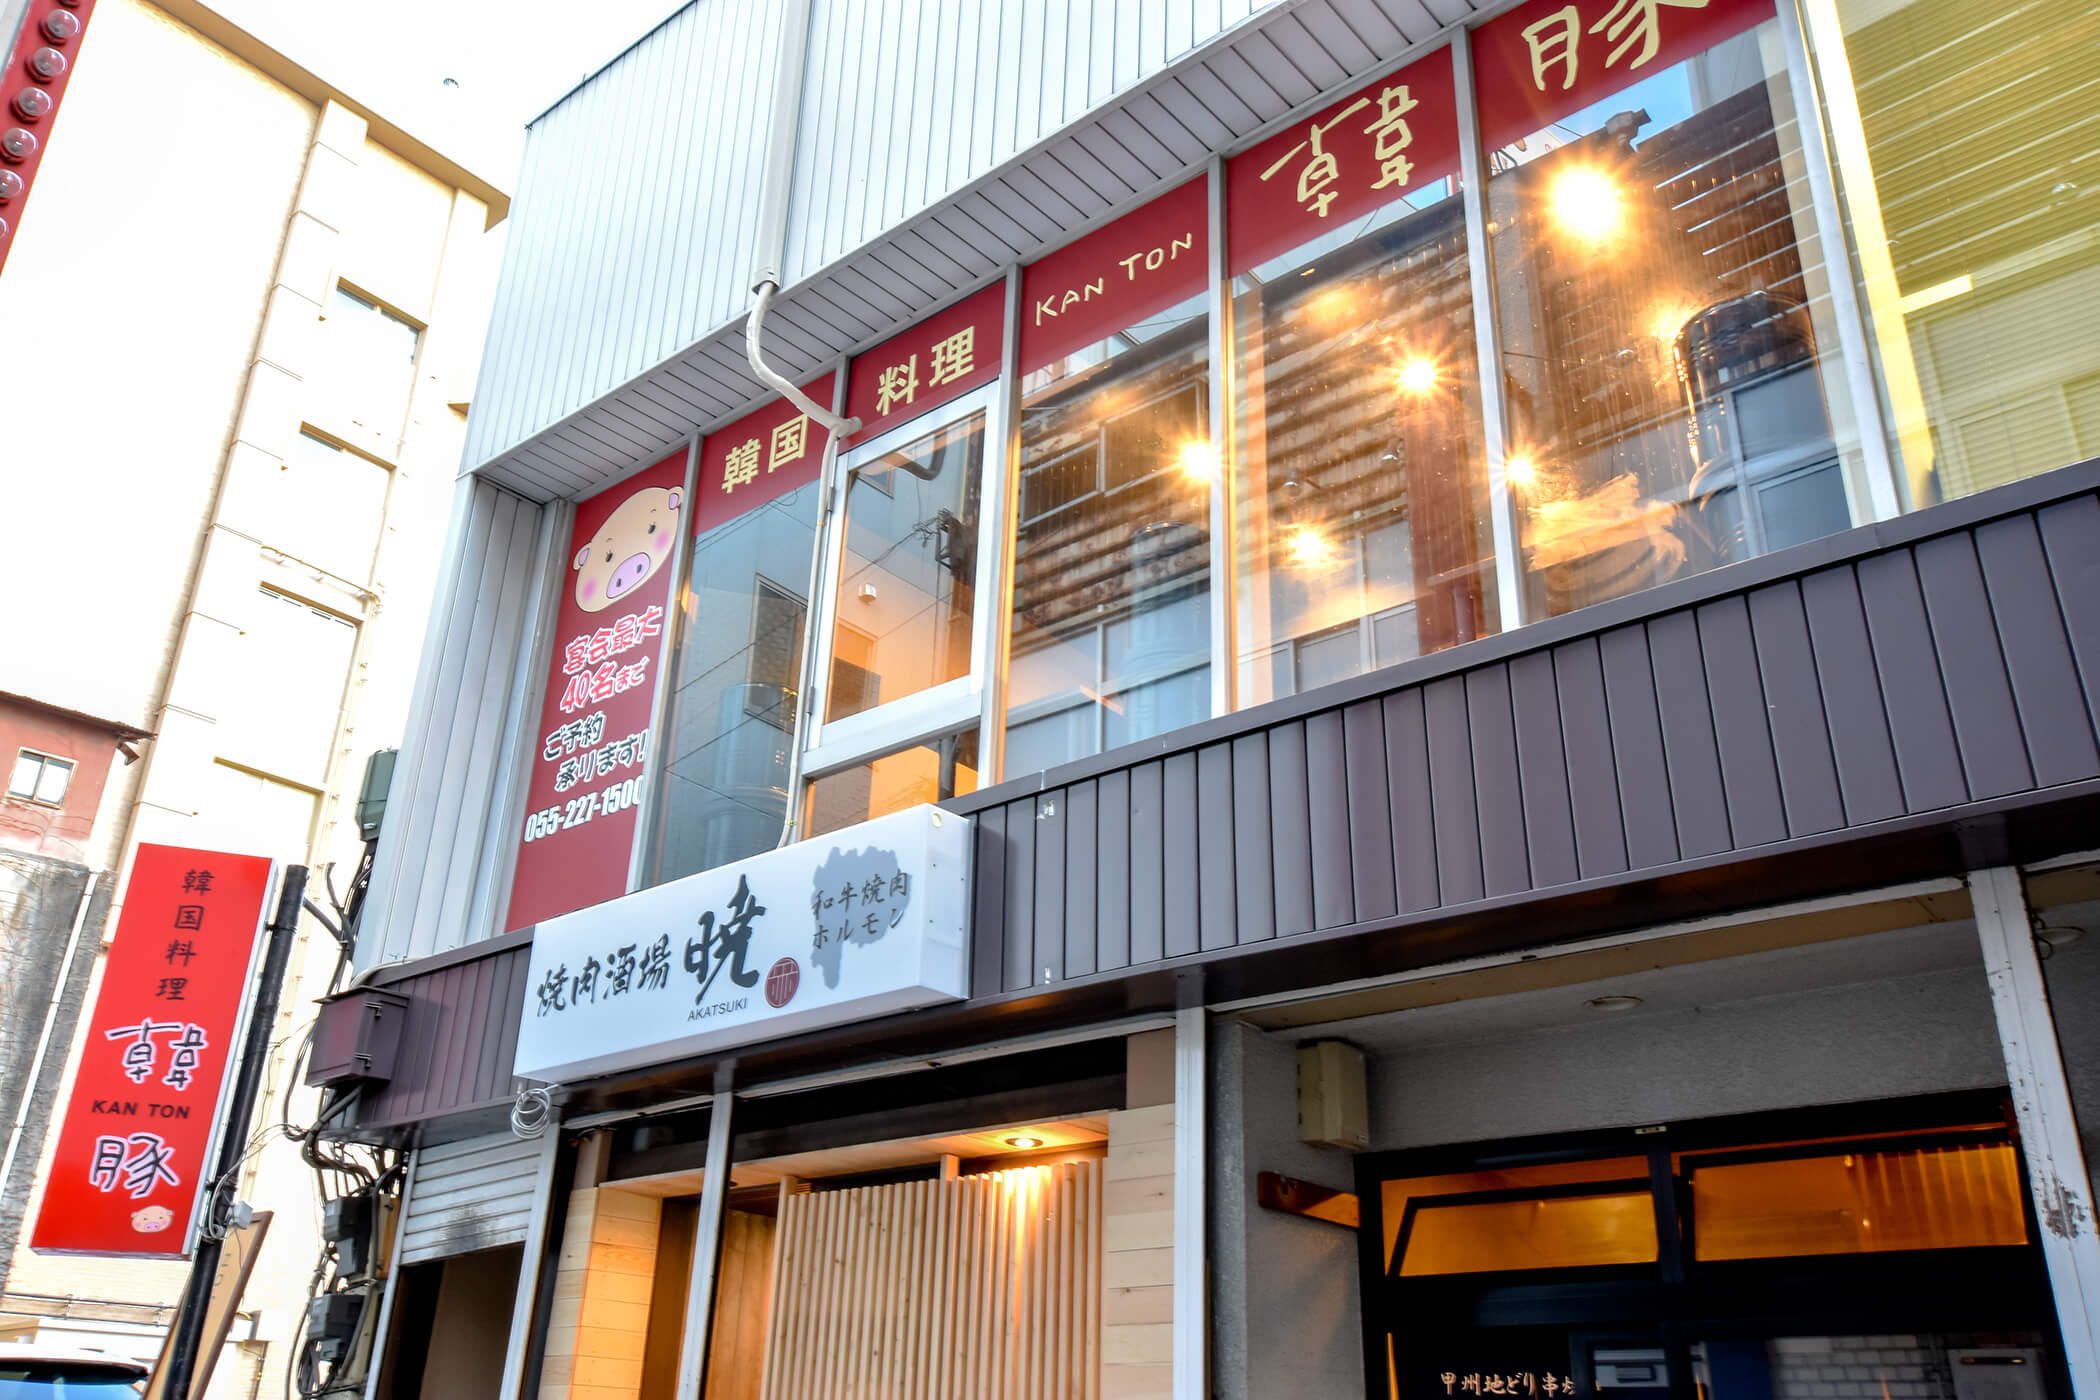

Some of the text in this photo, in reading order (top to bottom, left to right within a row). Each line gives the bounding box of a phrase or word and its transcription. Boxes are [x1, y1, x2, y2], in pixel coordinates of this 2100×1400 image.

[1035, 232, 1192, 326] KAN TON
[563, 606, 664, 675] 宴会最大
[559, 655, 650, 713] 40名まで
[543, 711, 606, 761] ご予約
[811, 867, 907, 920] 和牛焼肉
[155, 869, 215, 1001] 韓国料理
[813, 908, 904, 949] ホルモン
[537, 933, 673, 1017] 焼肉酒場
[687, 998, 748, 1022] AKATSUKI
[91, 1100, 190, 1119] KAN TON
